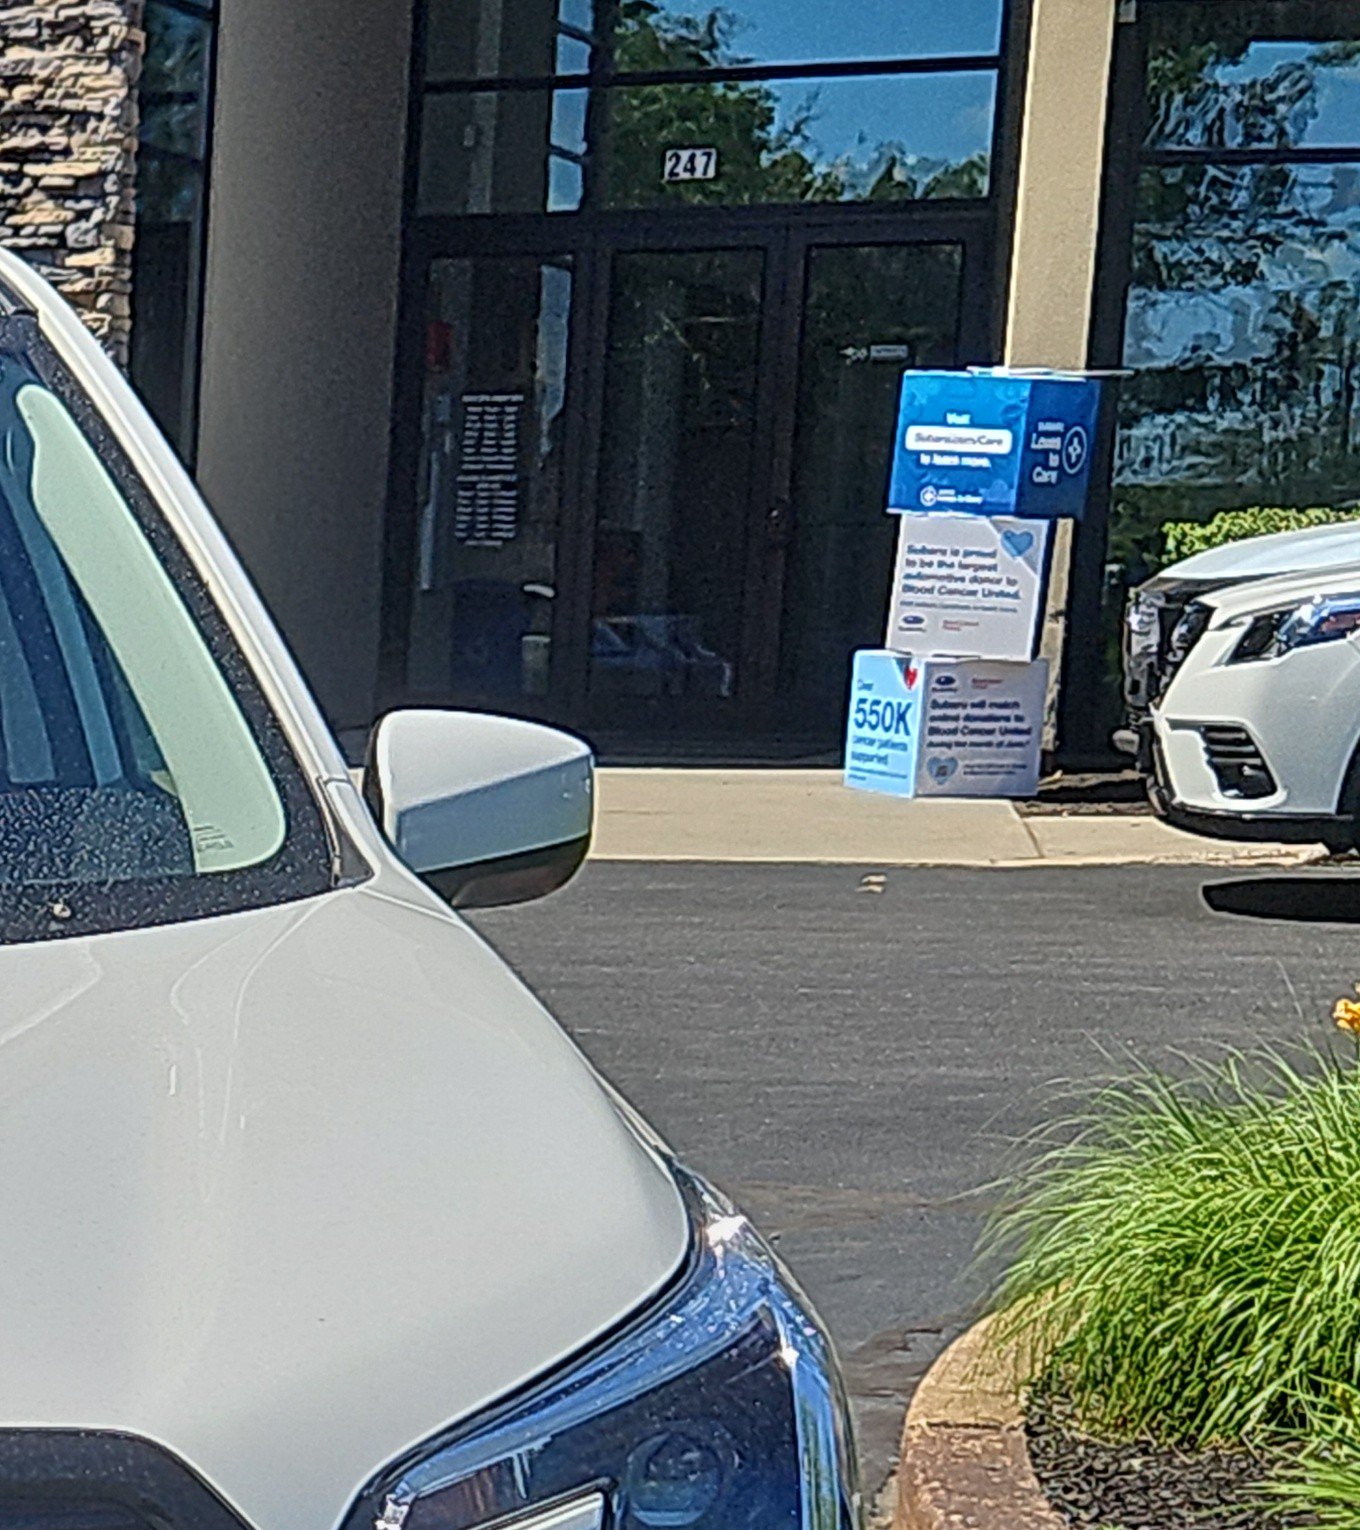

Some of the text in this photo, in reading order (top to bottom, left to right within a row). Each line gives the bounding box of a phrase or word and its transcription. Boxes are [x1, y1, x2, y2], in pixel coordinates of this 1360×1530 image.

[668, 151, 713, 178] 247
[907, 545, 997, 558] Subaru is proud
[905, 559, 998, 572] to be the largest
[903, 572, 1018, 586] automotive donor to
[902, 584, 934, 595] Blood
[937, 586, 978, 596] Cancer
[930, 699, 967, 709] Subaru
[854, 698, 912, 736] 550K
[928, 726, 958, 736] Blood
[960, 725, 996, 736] Cancer
